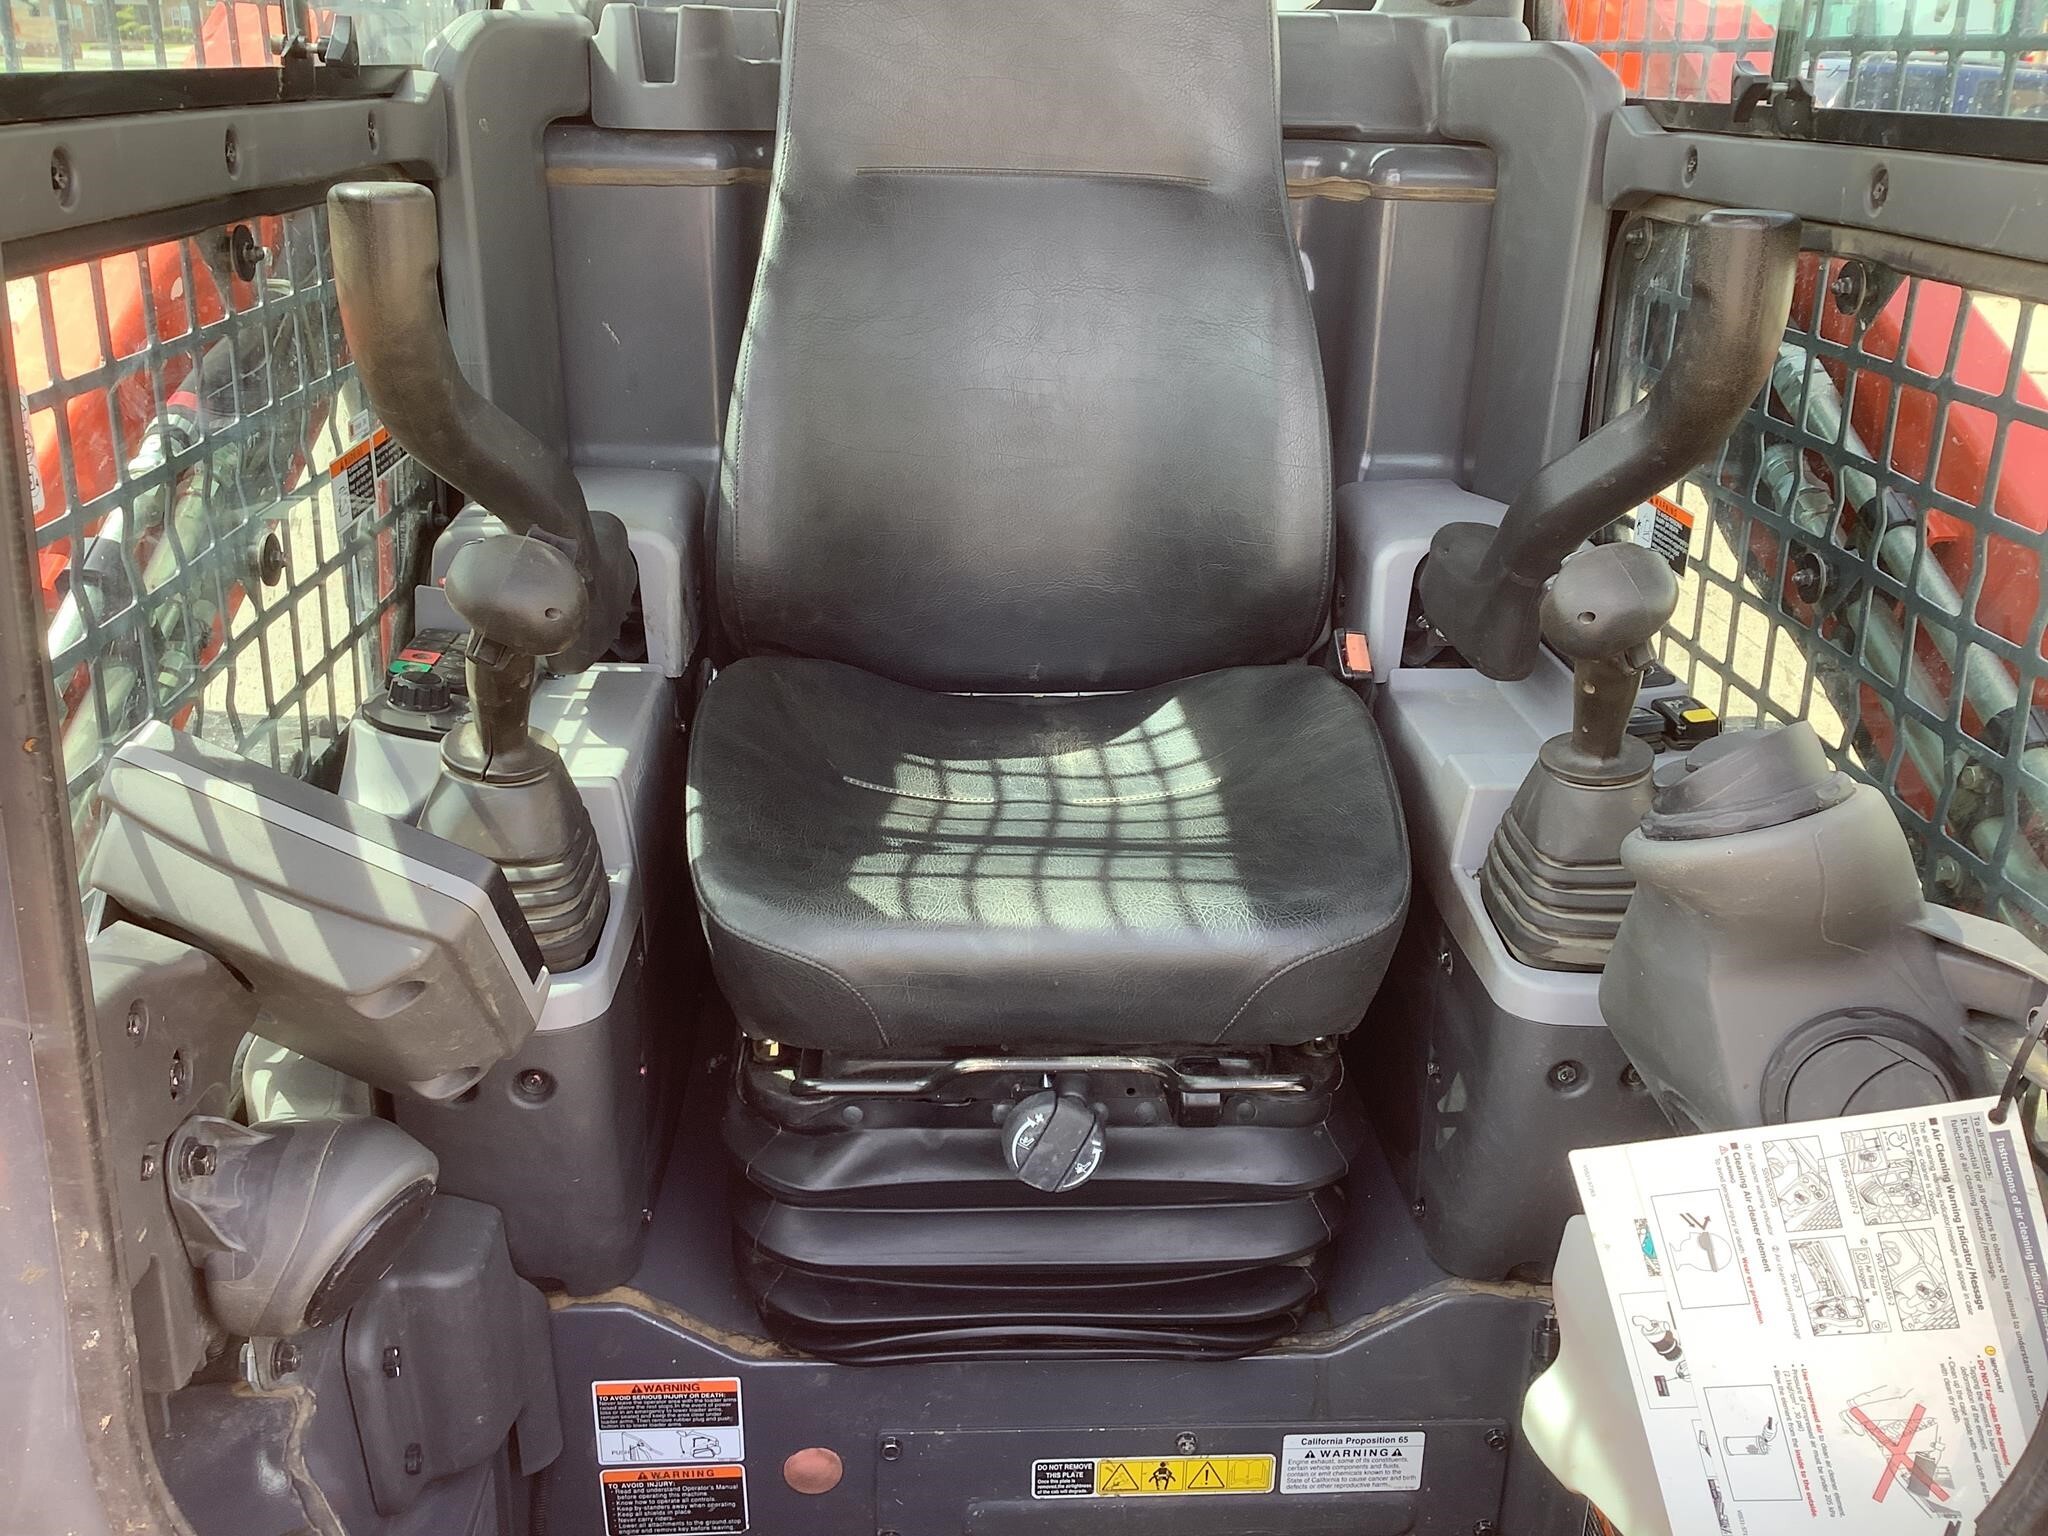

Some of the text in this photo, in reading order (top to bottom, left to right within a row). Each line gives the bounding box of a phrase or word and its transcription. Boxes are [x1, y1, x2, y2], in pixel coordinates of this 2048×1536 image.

[1960, 1118, 1968, 1126] It
[1965, 1135, 1978, 1169] essential
[1973, 1116, 1993, 1179] To all operators:
[1996, 1137, 2017, 1193] Instructions
[1973, 1171, 1983, 1182] for
[1977, 1183, 1986, 1193] all
[1951, 1119, 1997, 1281] function of air cleaning indicator/message.
[2011, 1195, 2021, 1205] of
[1732, 1152, 1770, 1272] Cleaning Air cleaner element
[1980, 1195, 1994, 1232] operators
[2013, 1206, 2025, 1220] air
[1931, 1128, 1985, 1310] Air Cleaning Warning Indicator/Message
[1989, 1233, 1998, 1242] to
[2016, 1221, 2035, 1260] cleaning
[1993, 1243, 2005, 1273] observe
[1741, 1256, 1751, 1275] Wear
[1745, 1276, 1754, 1288] eye
[2000, 1275, 2011, 1290] this
[2005, 1291, 2017, 1319] manual
[2012, 1321, 2021, 1330] to
[2016, 1330, 2032, 1373] understand
[1977, 1359, 1986, 1371] DO
[1980, 1372, 1990, 1388] NOT
[1990, 1357, 2003, 1393] IMPORTANT
[2026, 1375, 2036, 1388] the
[644, 1383, 700, 1392] WARNING
[1984, 1389, 1998, 1422] tap-clean
[1993, 1423, 2003, 1436] the
[1301, 1437, 1343, 1446] California
[1345, 1436, 1396, 1446] Proposition
[1320, 1448, 1388, 1458] WARNING
[1048, 1463, 1063, 1471] NOT
[1064, 1462, 1092, 1470] REMOVE
[650, 1469, 715, 1479] WARNING
[1045, 1471, 1061, 1479] THIS
[646, 1480, 676, 1488] INJURY:
